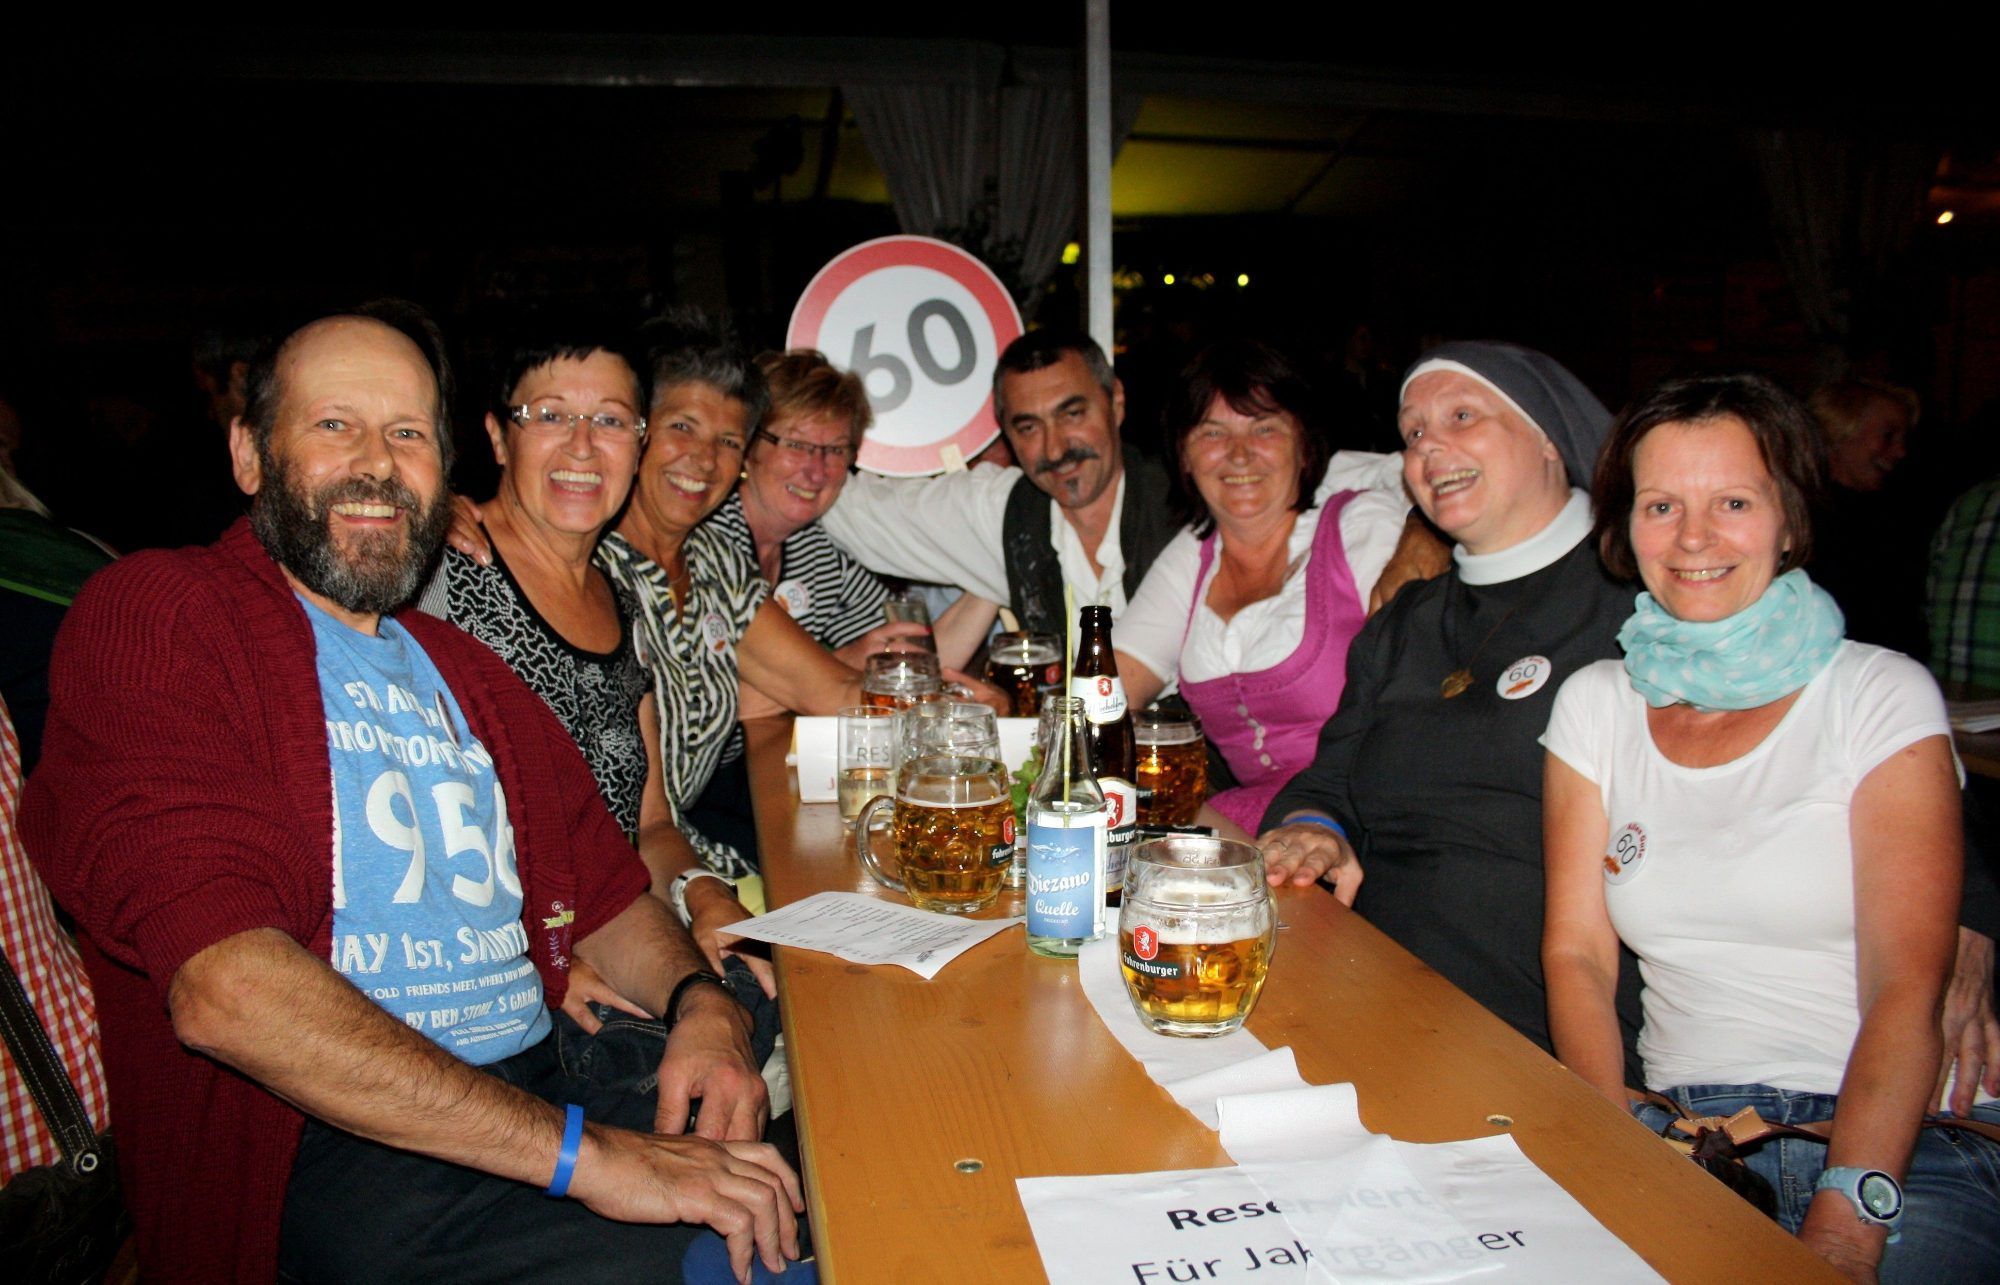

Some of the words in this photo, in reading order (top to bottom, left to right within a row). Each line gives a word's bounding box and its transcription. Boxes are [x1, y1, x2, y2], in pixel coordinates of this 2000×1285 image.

[850, 298, 978, 414] 60
[1509, 664, 1538, 682] 60
[1616, 833, 1637, 865] 60
[1035, 899, 1080, 916] Quelle
[401, 932, 453, 972] 1ST,
[374, 987, 400, 1000] OLD
[405, 983, 450, 998] FRIENDS
[452, 979, 477, 993] MEET,
[479, 973, 504, 988] WHERE
[405, 1011, 426, 1030] BY
[430, 1008, 460, 1028] BEN
[1131, 1258, 1221, 1285] Für
